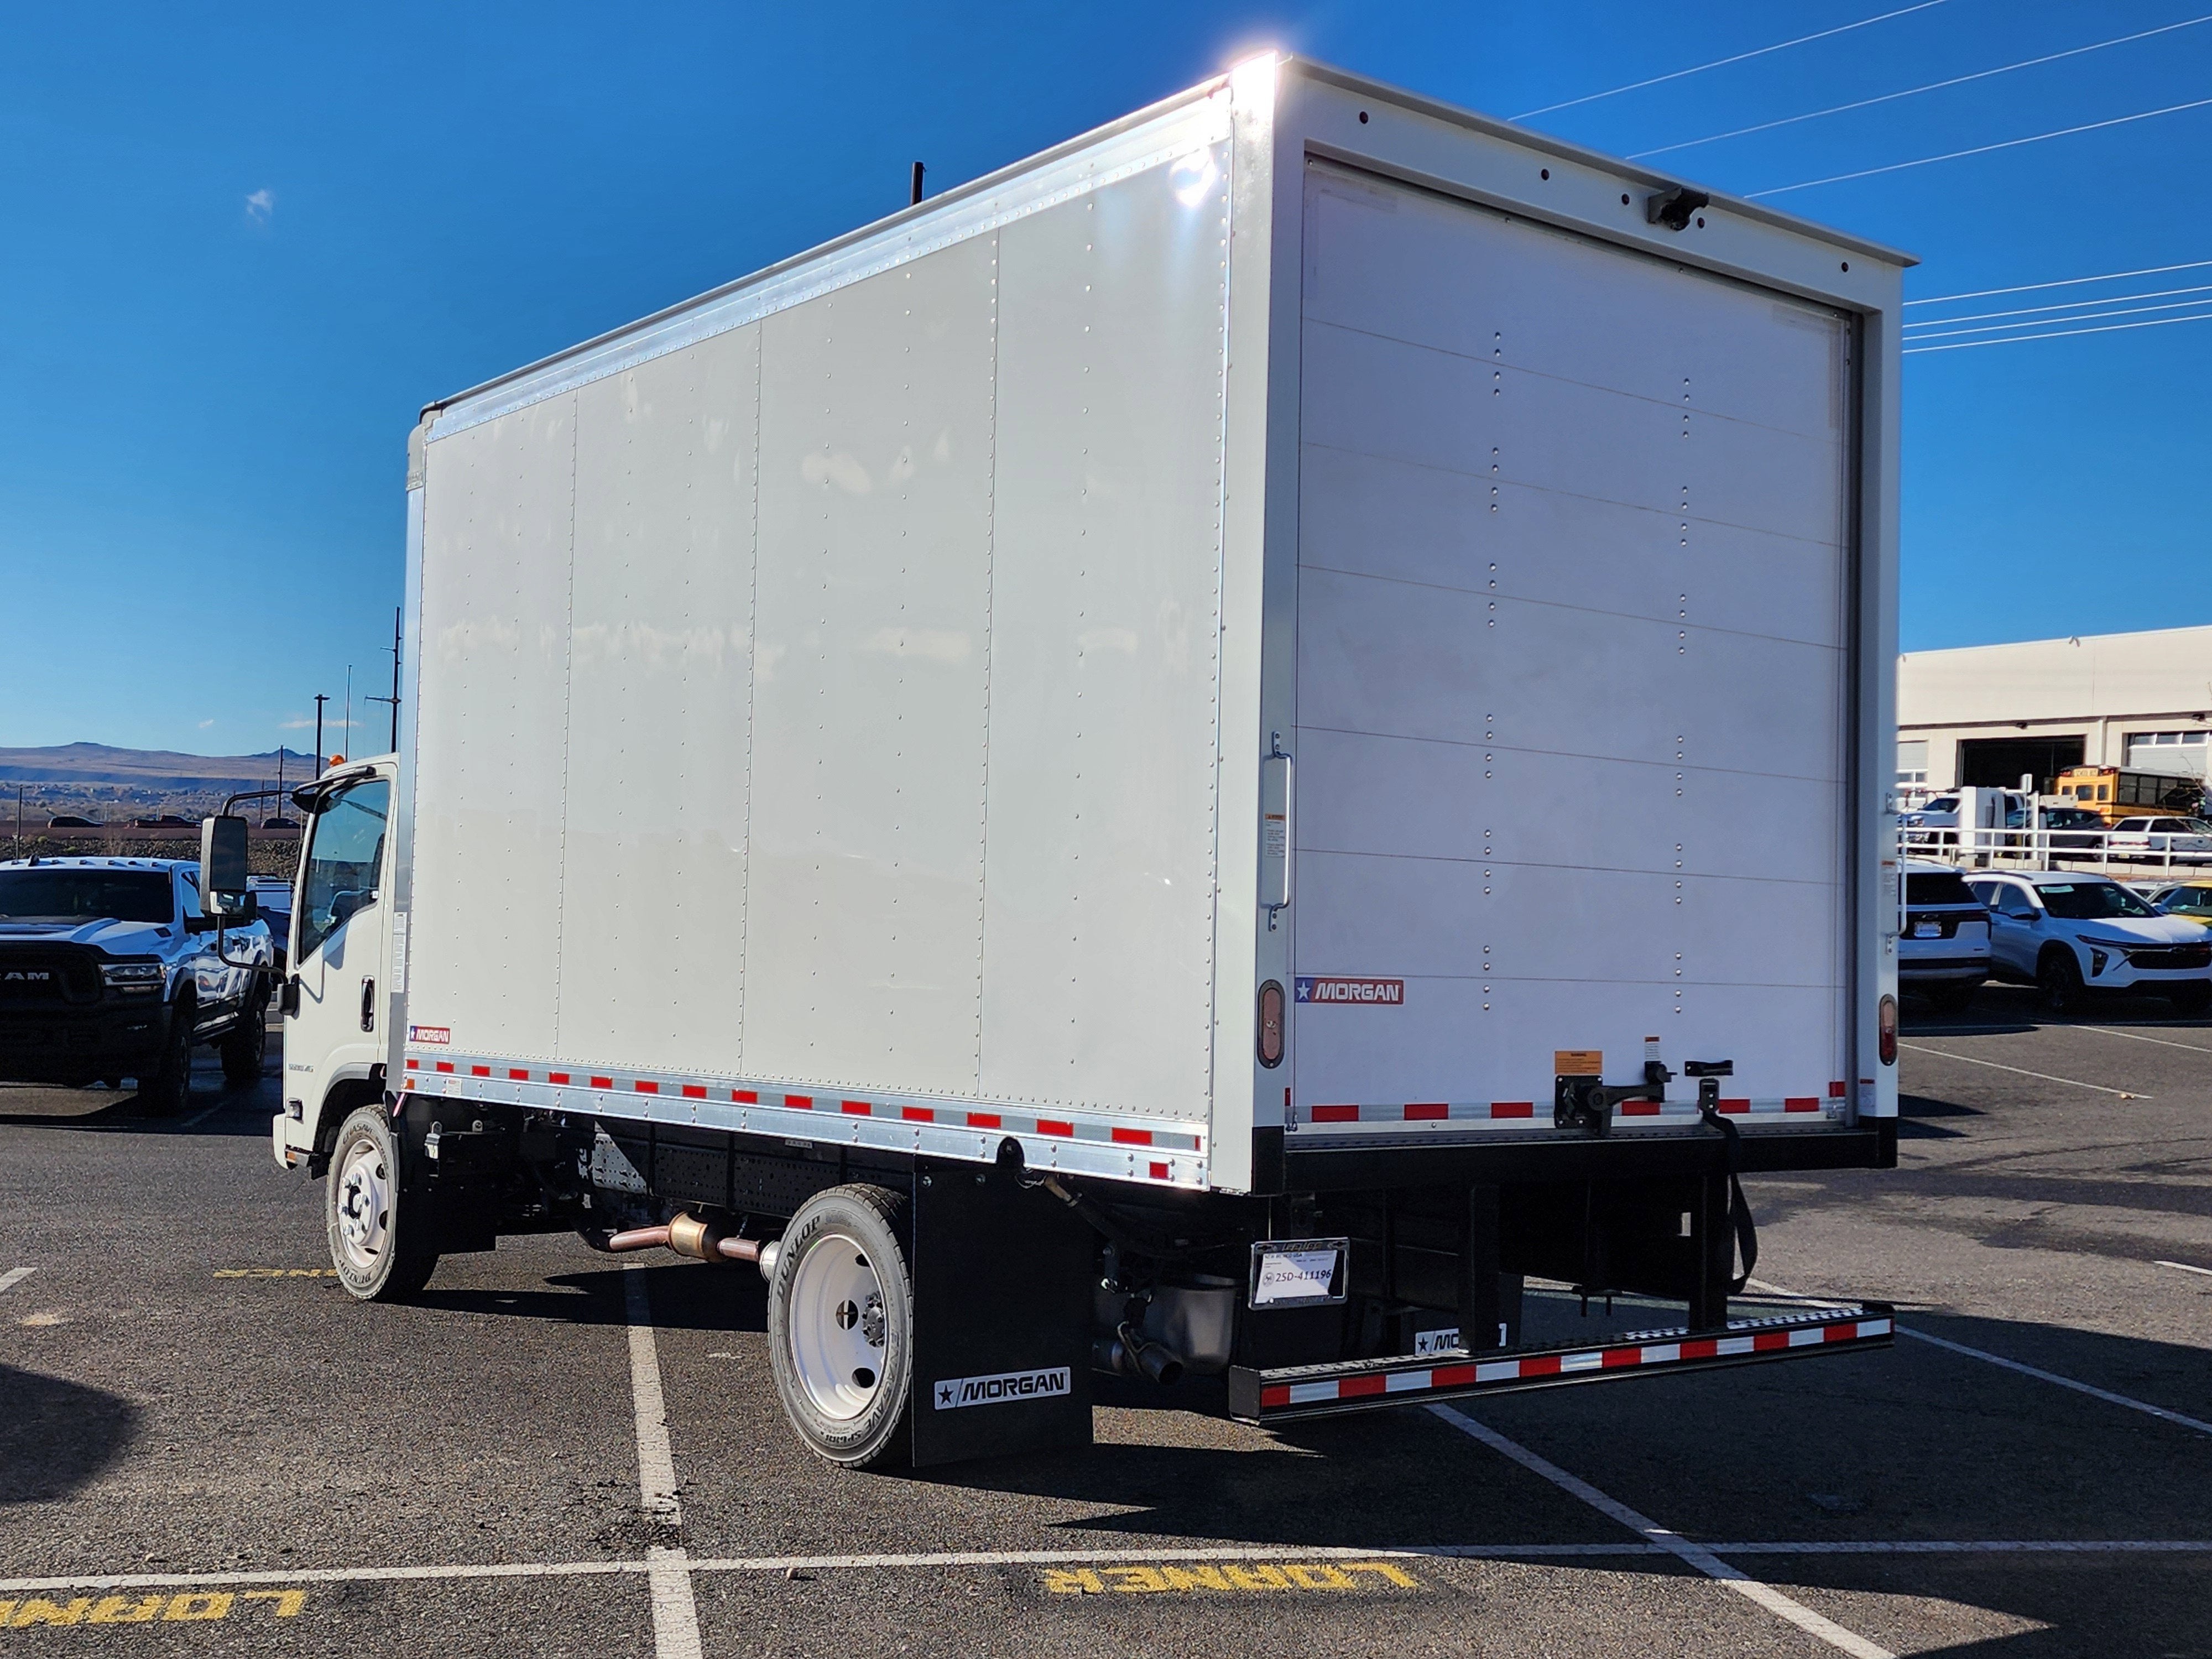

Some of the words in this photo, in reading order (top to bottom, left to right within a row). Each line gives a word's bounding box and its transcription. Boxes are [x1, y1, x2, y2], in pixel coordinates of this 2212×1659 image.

[1315, 982, 1399, 1001] MORGAN
[416, 1029, 449, 1042] MORGAN
[777, 1215, 820, 1304] DUNLOP
[1275, 1269, 1331, 1282] 25D-411196
[962, 1373, 1064, 1402] MORGAN
[1043, 1563, 1418, 1594] LOANER
